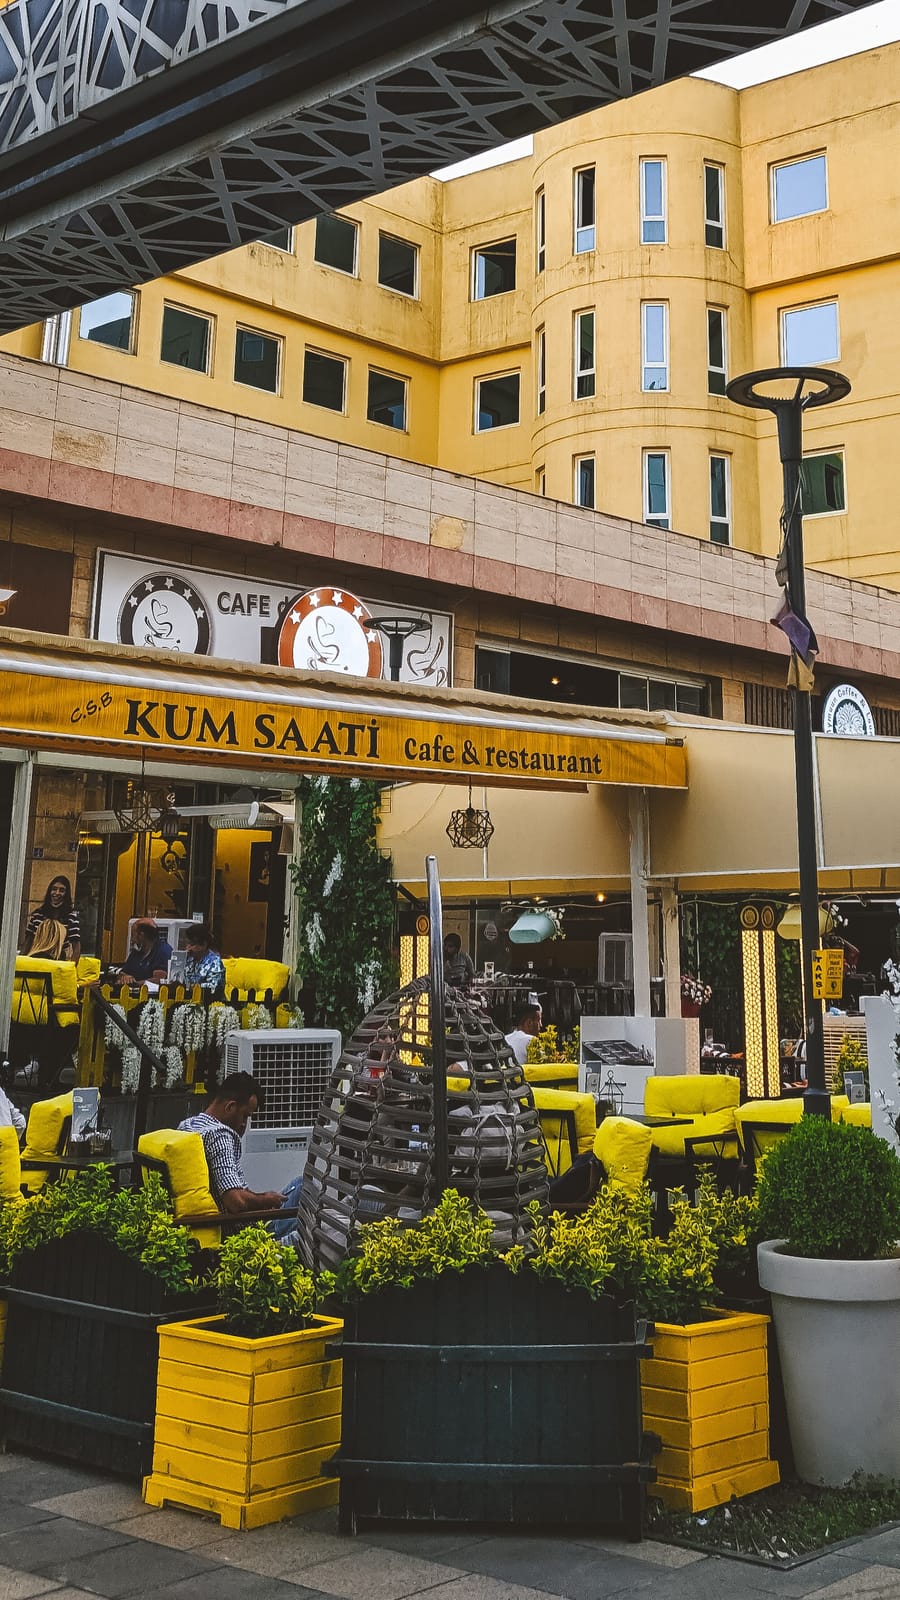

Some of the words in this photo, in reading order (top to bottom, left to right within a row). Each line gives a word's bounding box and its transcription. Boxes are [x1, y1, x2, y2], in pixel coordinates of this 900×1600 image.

[217, 591, 271, 618] CAFE
[124, 699, 240, 746] KUM
[254, 714, 380, 759] SAATİ
[461, 739, 480, 765] &
[485, 746, 603, 775] restaurant
